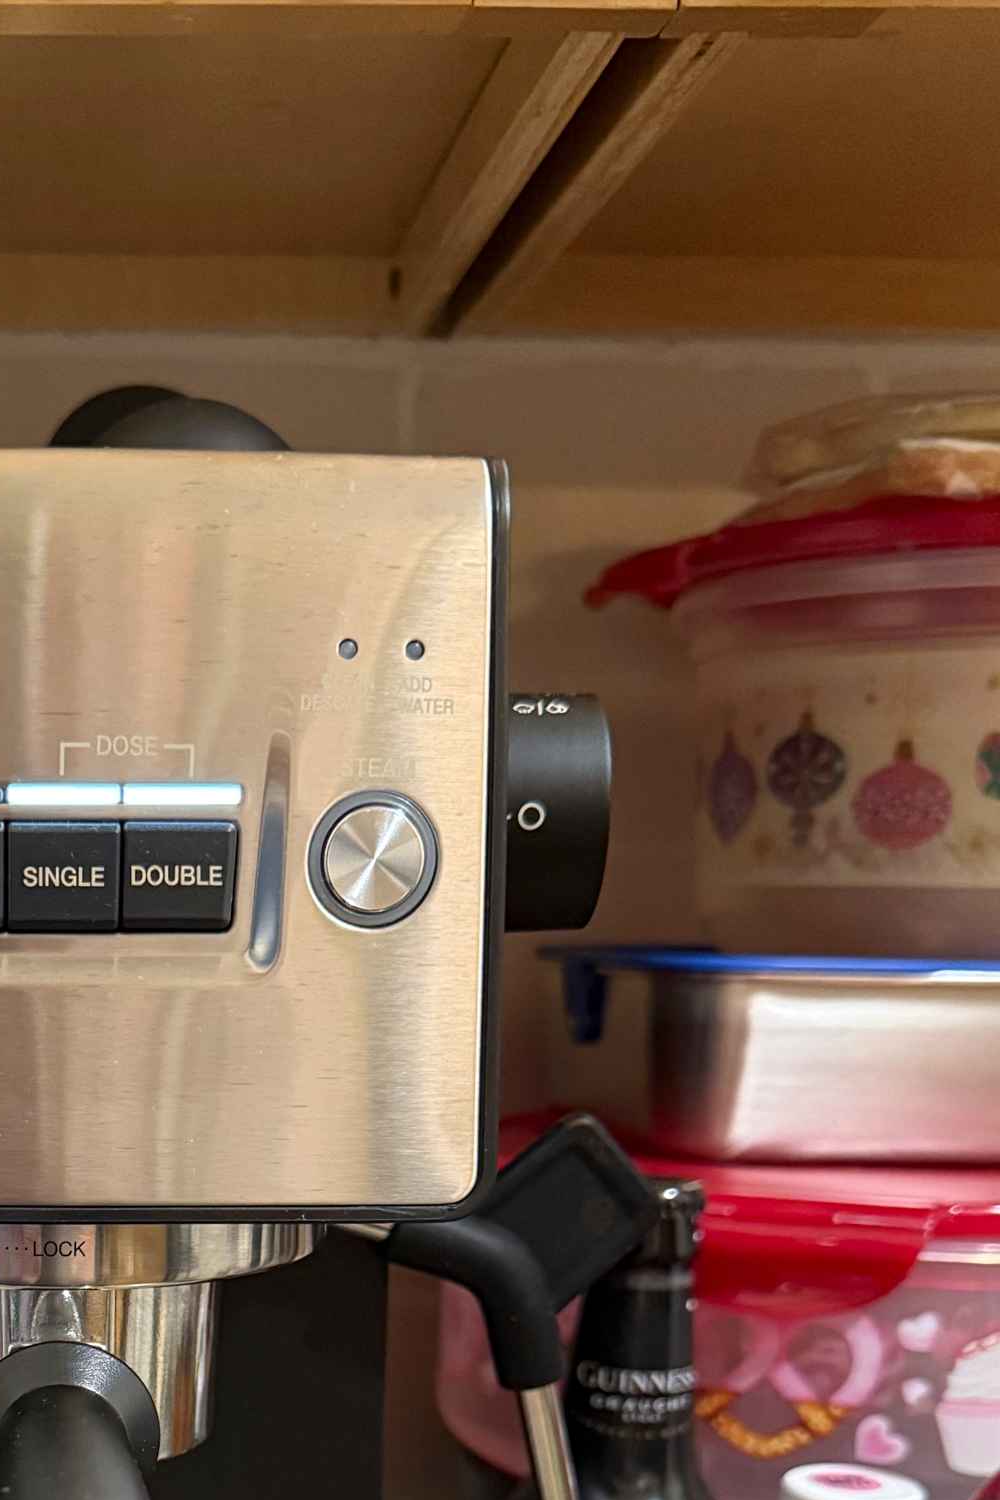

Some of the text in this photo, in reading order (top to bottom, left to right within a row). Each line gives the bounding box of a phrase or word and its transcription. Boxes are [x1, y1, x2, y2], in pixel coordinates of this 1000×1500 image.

[392, 676, 432, 692] ADD
[300, 694, 376, 712] DESCE
[397, 698, 455, 715] WATER
[96, 736, 159, 757] DOSE
[341, 757, 416, 778] STEAM
[23, 866, 105, 888] SINGLE
[130, 865, 223, 887] DOUBLE
[32, 1241, 86, 1258] LOCK
